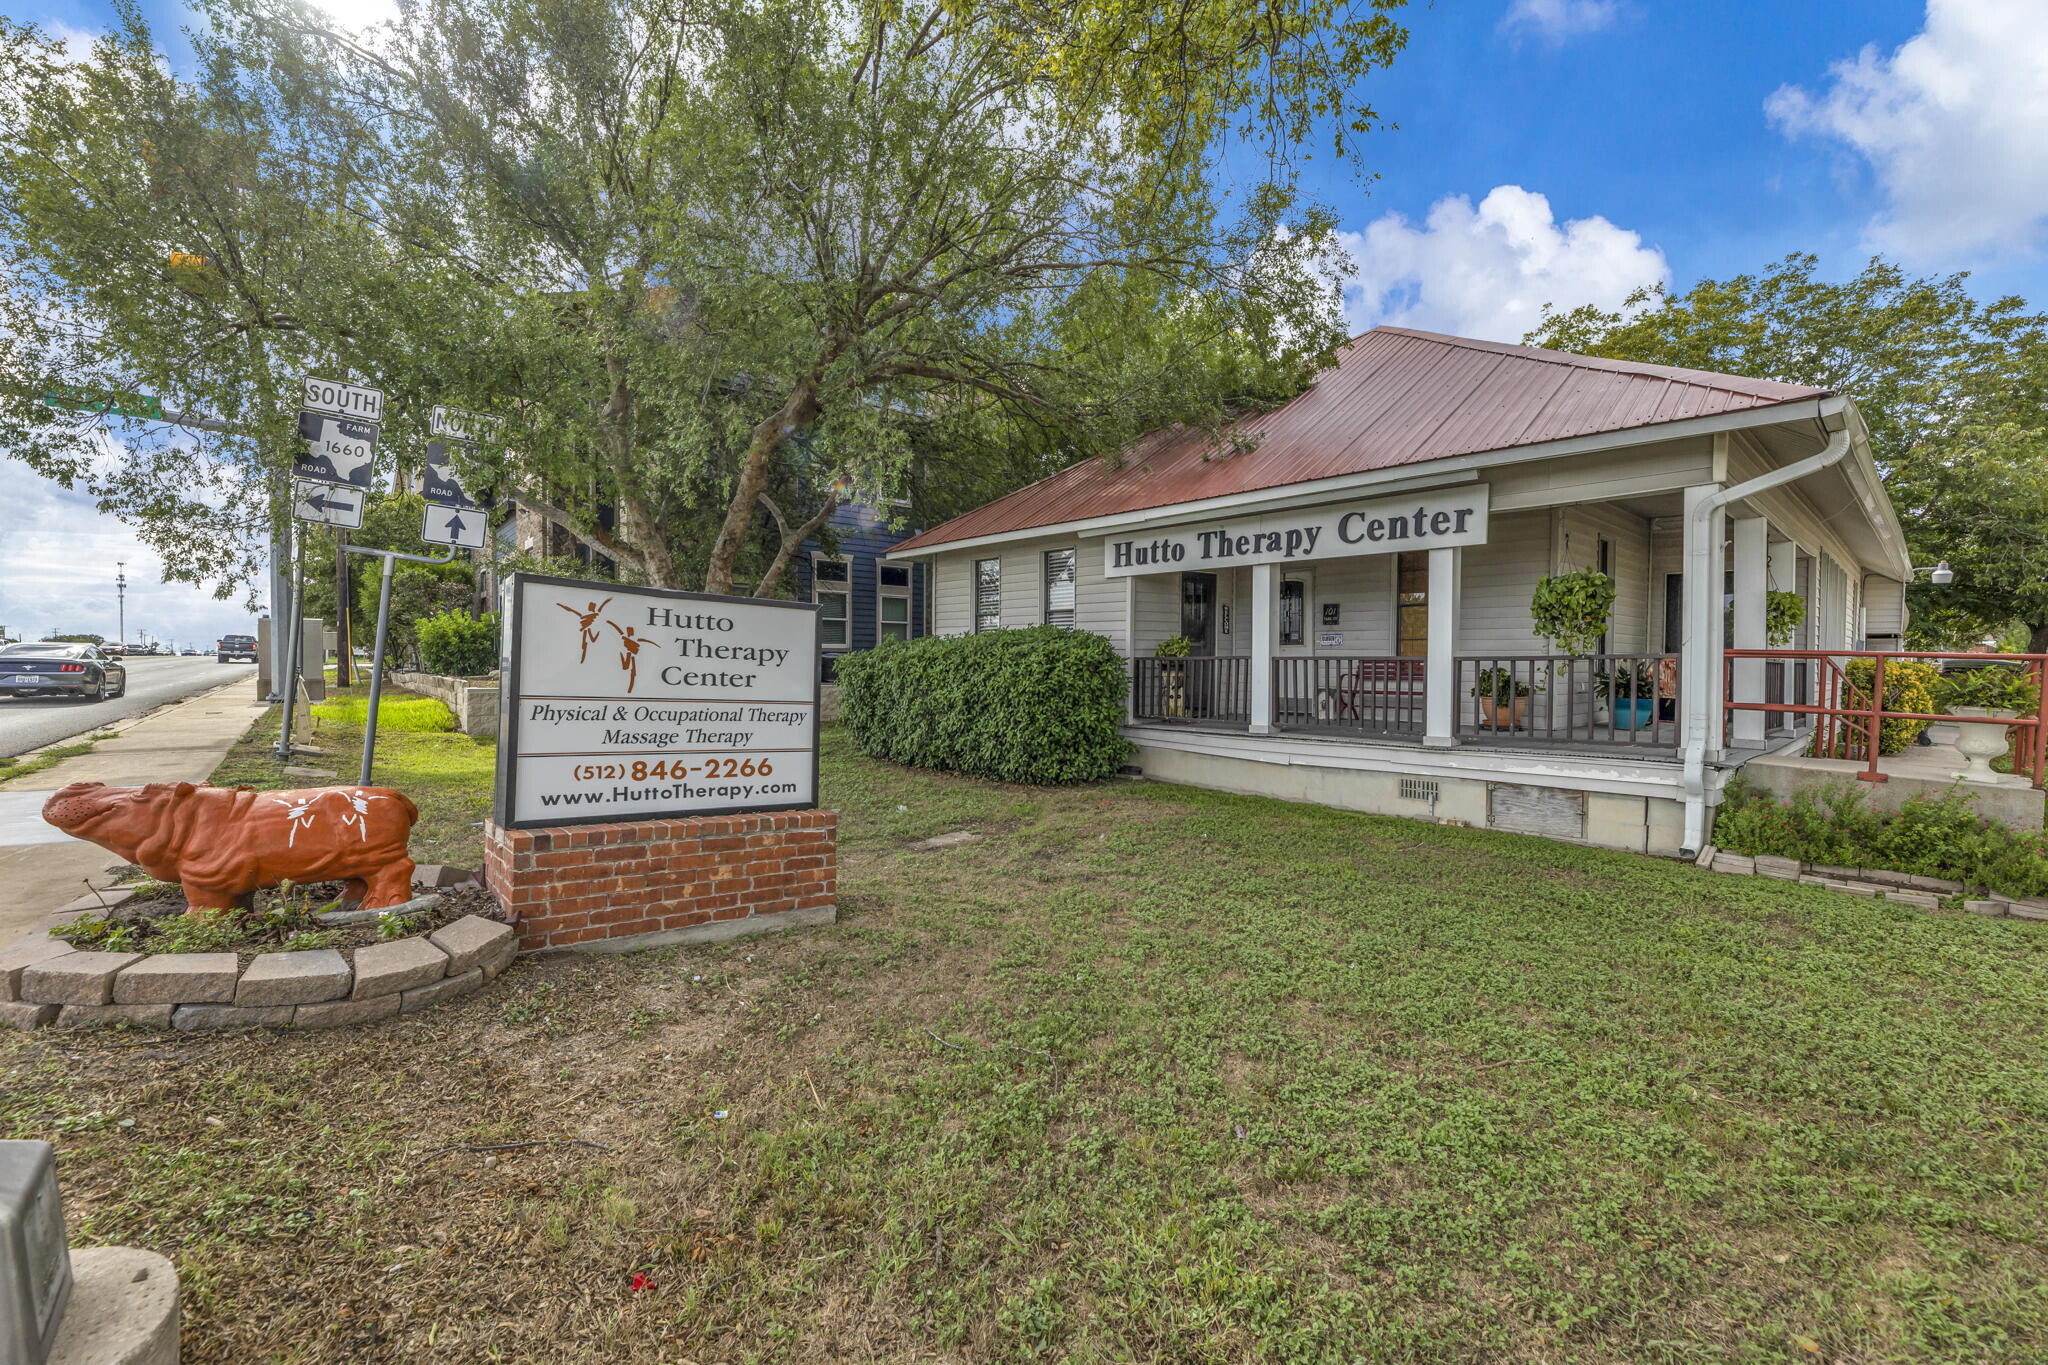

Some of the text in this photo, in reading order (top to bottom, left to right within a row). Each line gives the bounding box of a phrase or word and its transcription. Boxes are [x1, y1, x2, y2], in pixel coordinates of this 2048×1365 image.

[307, 385, 376, 413] SOUTH
[346, 423, 371, 434] FARM
[325, 440, 364, 458] 1660
[301, 464, 327, 474] ROAD
[430, 487, 453, 497] ROAD
[1112, 506, 1474, 567] Hutto Therapy Center
[646, 606, 734, 633] Hutto
[675, 637, 789, 666] Therapy
[661, 666, 757, 688] Center
[530, 704, 807, 726] Physical & Occupational Therapy
[602, 728, 754, 748] Massage Therapy
[573, 757, 773, 782] (512) 846-2266
[541, 780, 797, 807] www.HuttoTherapy.com
